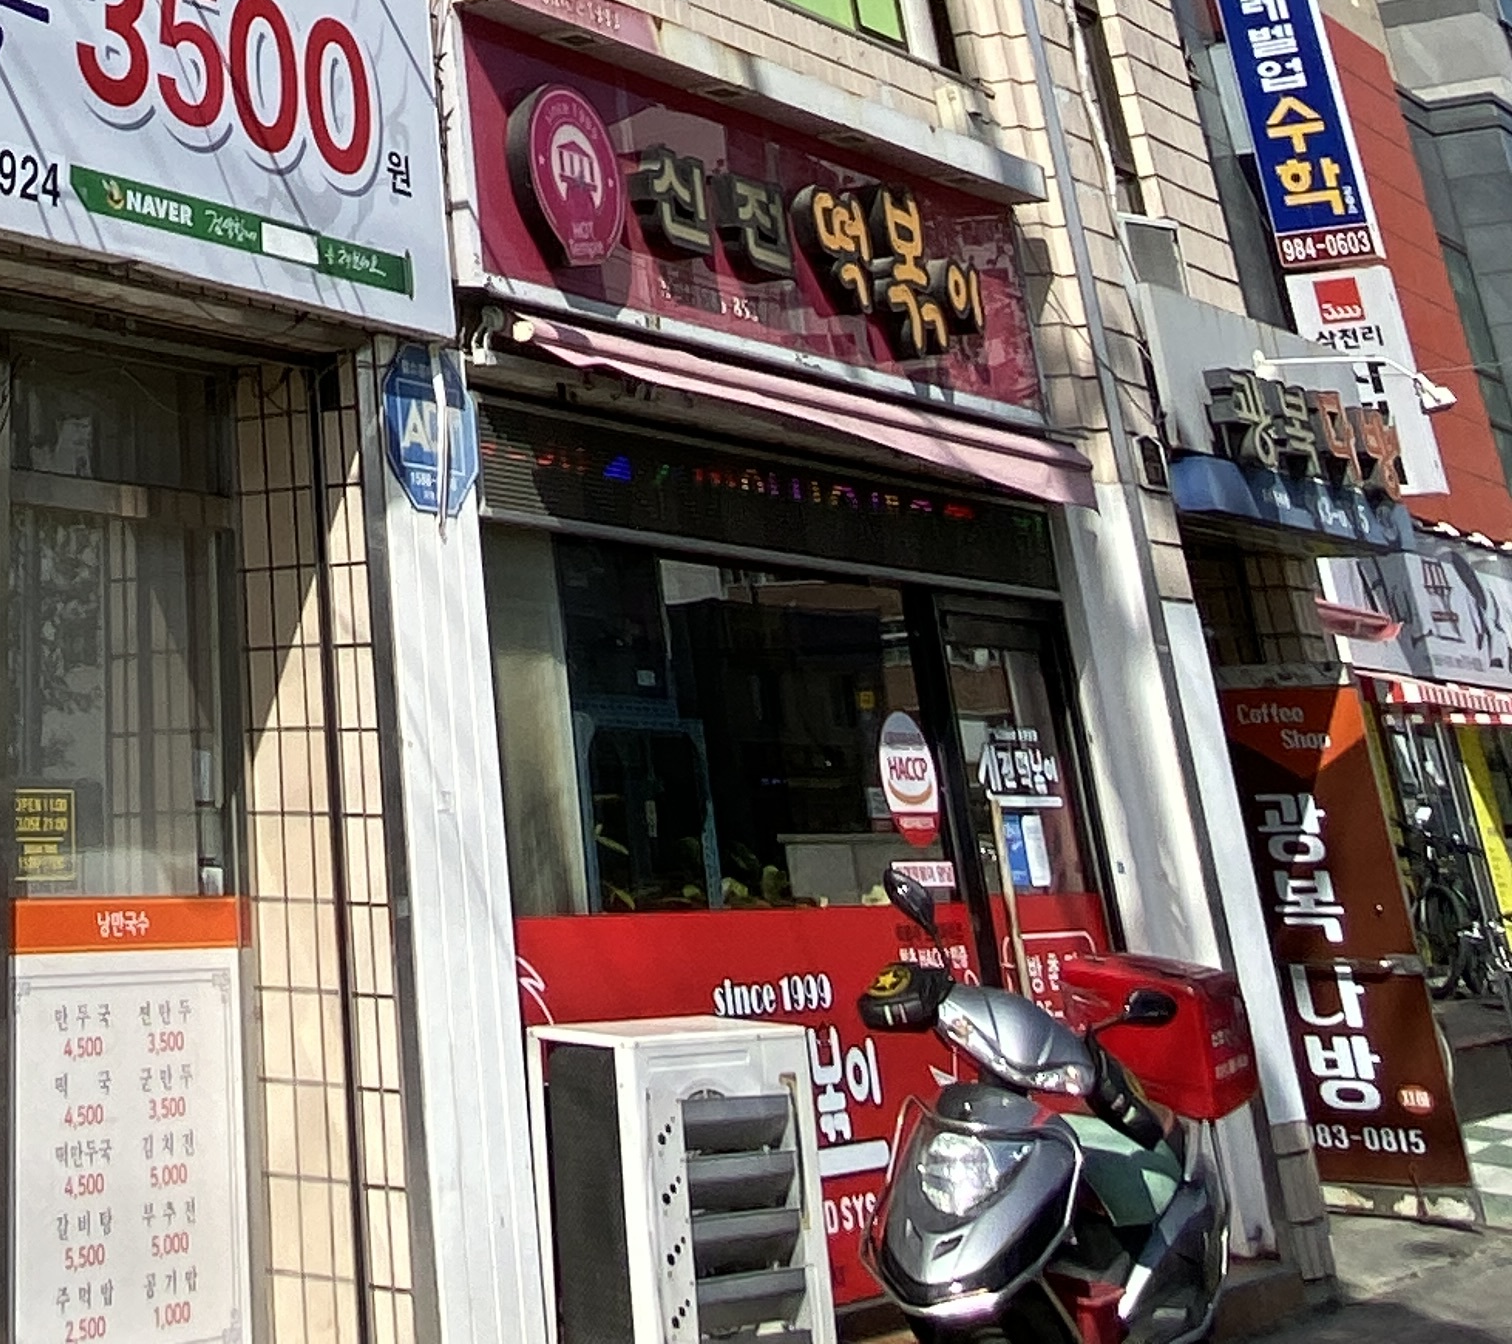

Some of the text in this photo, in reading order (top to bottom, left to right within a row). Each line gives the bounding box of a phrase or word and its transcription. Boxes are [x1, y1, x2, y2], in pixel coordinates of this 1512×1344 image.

[386, 150, 413, 198] 원
[1267, 94, 1346, 216] 수학
[126, 188, 194, 228] NAVER
[1281, 229, 1371, 262] 984-0603
[1280, 728, 1332, 751] Shop
[888, 756, 928, 782] HACCP
[1254, 792, 1346, 943] 광복
[96, 910, 151, 939] 낭만국수
[714, 973, 833, 1015] since 1999
[63, 1030, 185, 1062] 4,500 3,500
[64, 1095, 187, 1130] 4,500 3,500
[1310, 1121, 1427, 1155] 83-0815
[64, 1162, 188, 1201] 4,500 5,000
[64, 1230, 190, 1274] 5,500 5,000
[65, 1300, 192, 1344] 2,500 1,000
